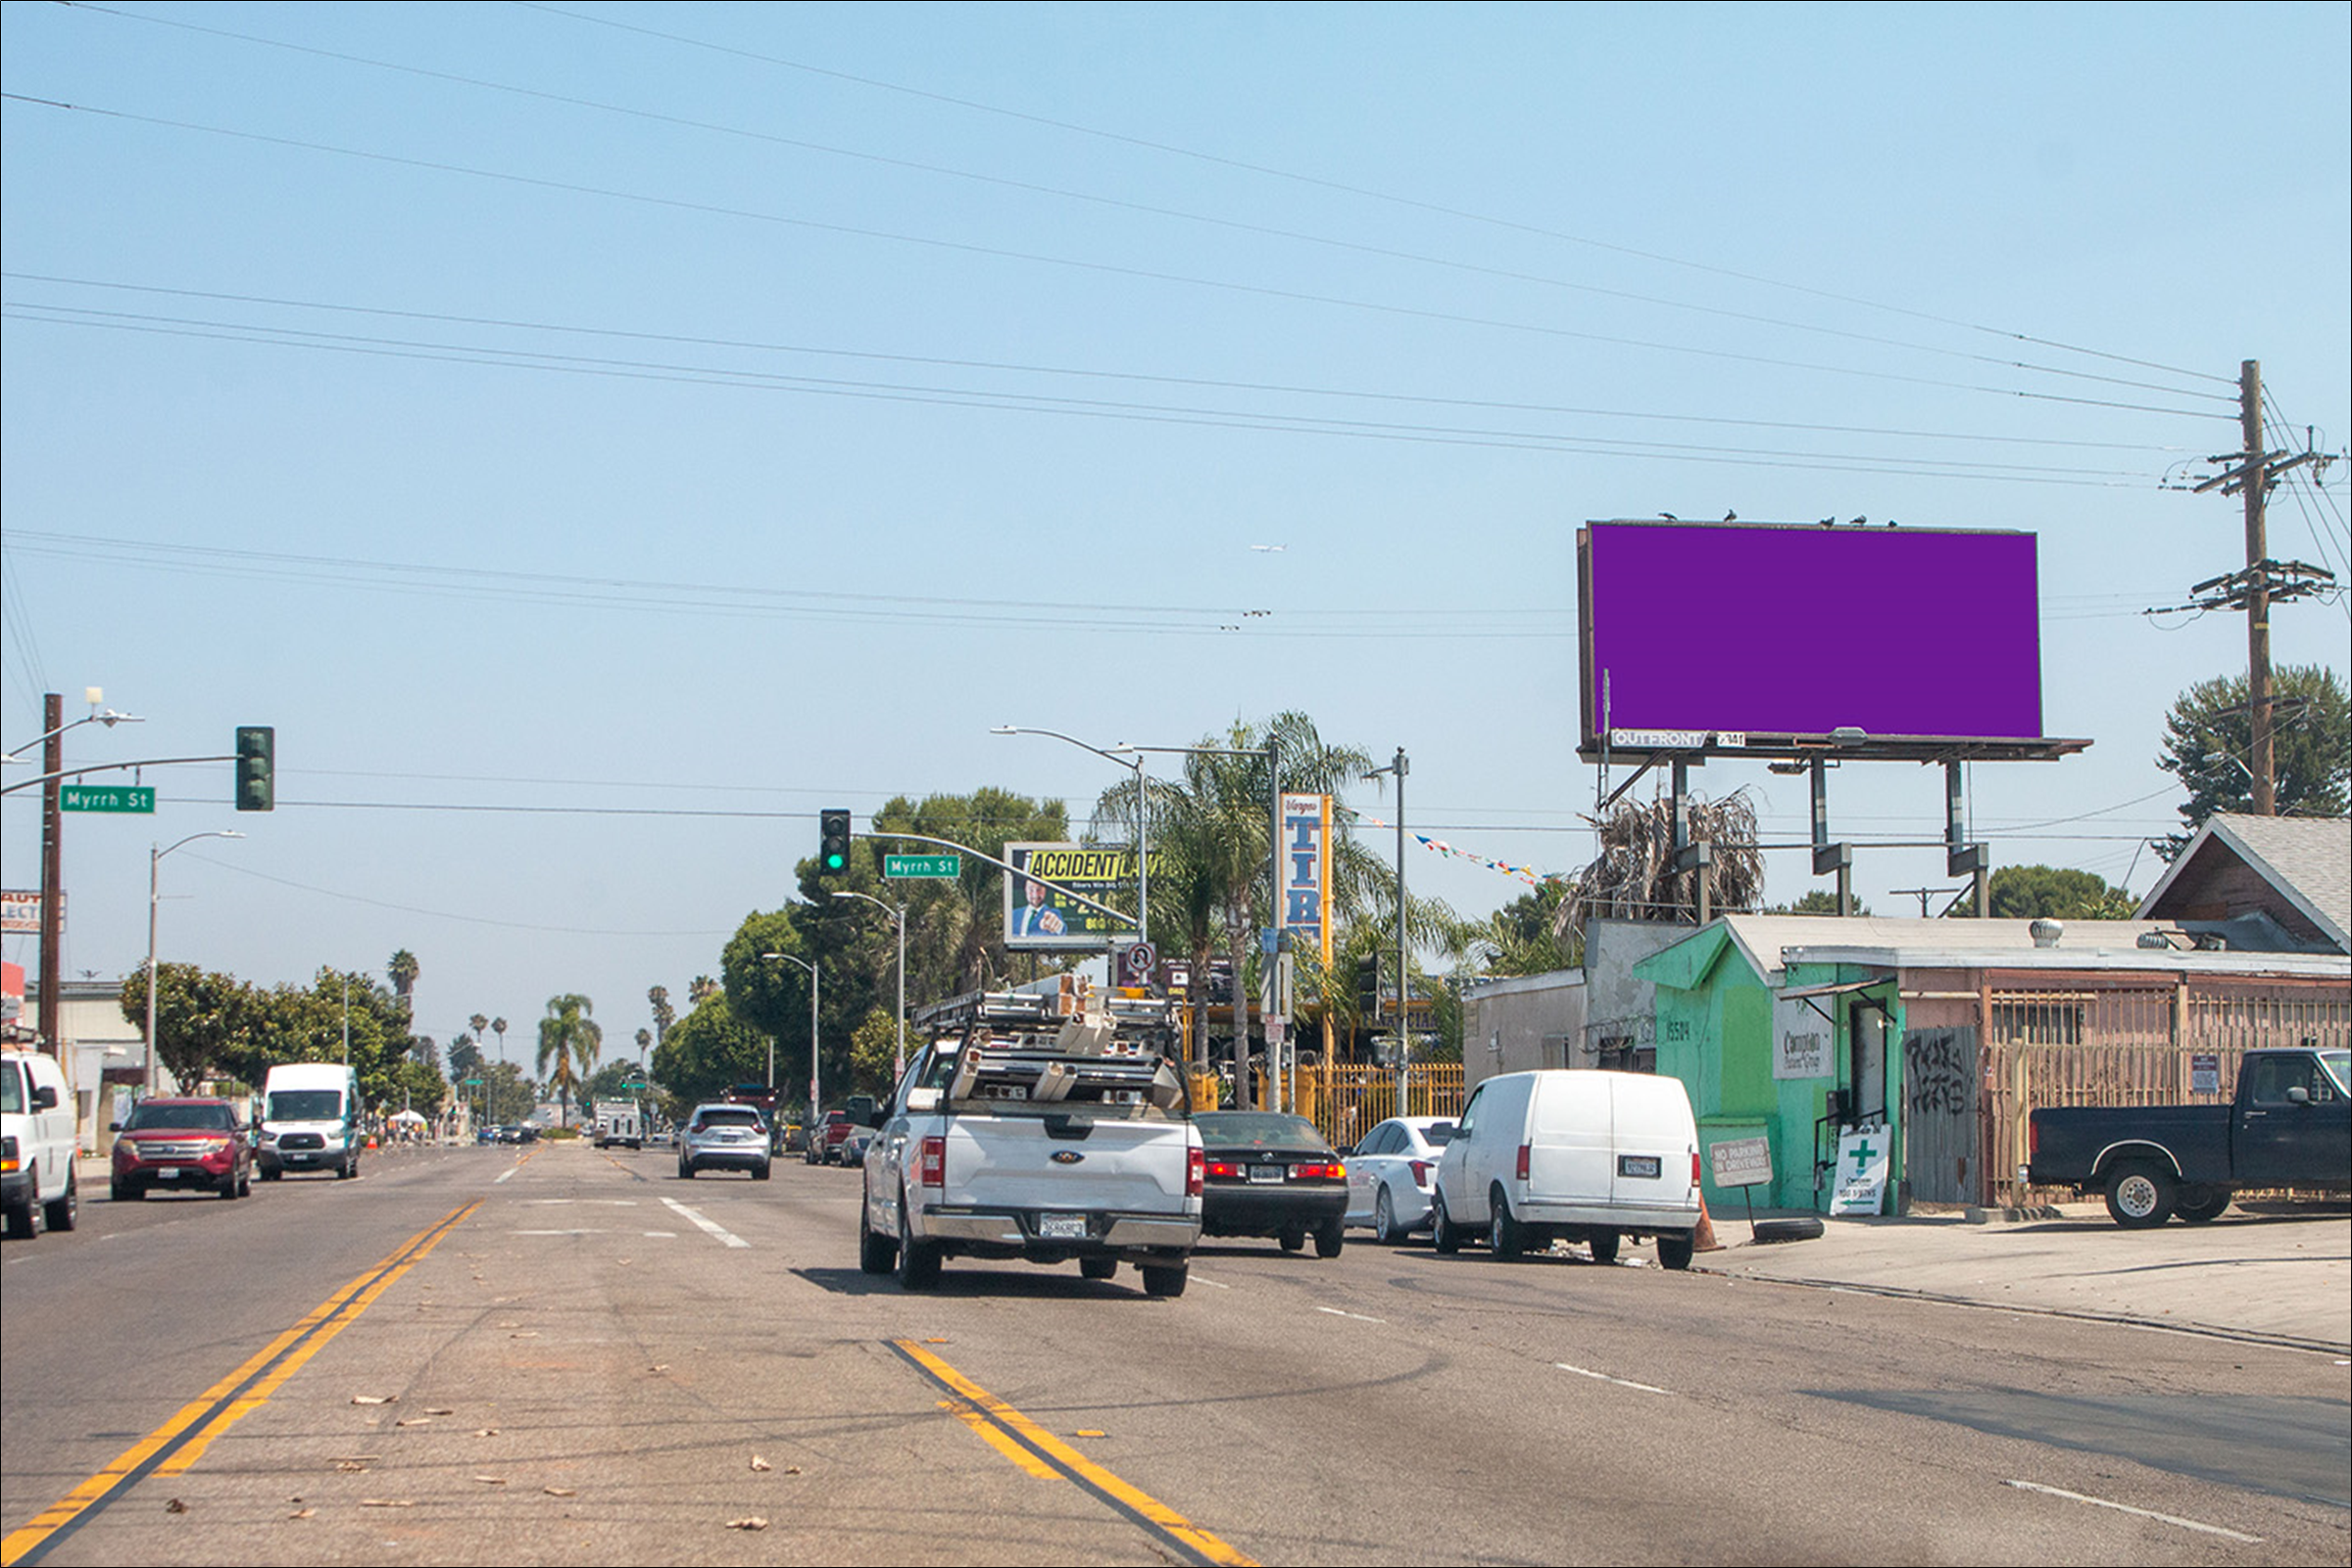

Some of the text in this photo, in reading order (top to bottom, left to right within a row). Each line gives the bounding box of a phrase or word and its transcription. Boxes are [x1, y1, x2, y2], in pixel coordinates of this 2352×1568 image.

[1614, 731, 1702, 745] OUTFRONT
[67, 791, 148, 809] Myrrh St
[891, 859, 954, 875] Myrrh St
[1031, 853, 1118, 878] ACCIDENT
[1286, 815, 1322, 941] TIR
[1, 893, 42, 904] AUT
[1, 905, 38, 919] ECT
[1783, 1030, 1821, 1054] Compton
[1714, 1144, 1765, 1161] NO PARKING
[1715, 1155, 1768, 1173] IN DRIVEWAY
